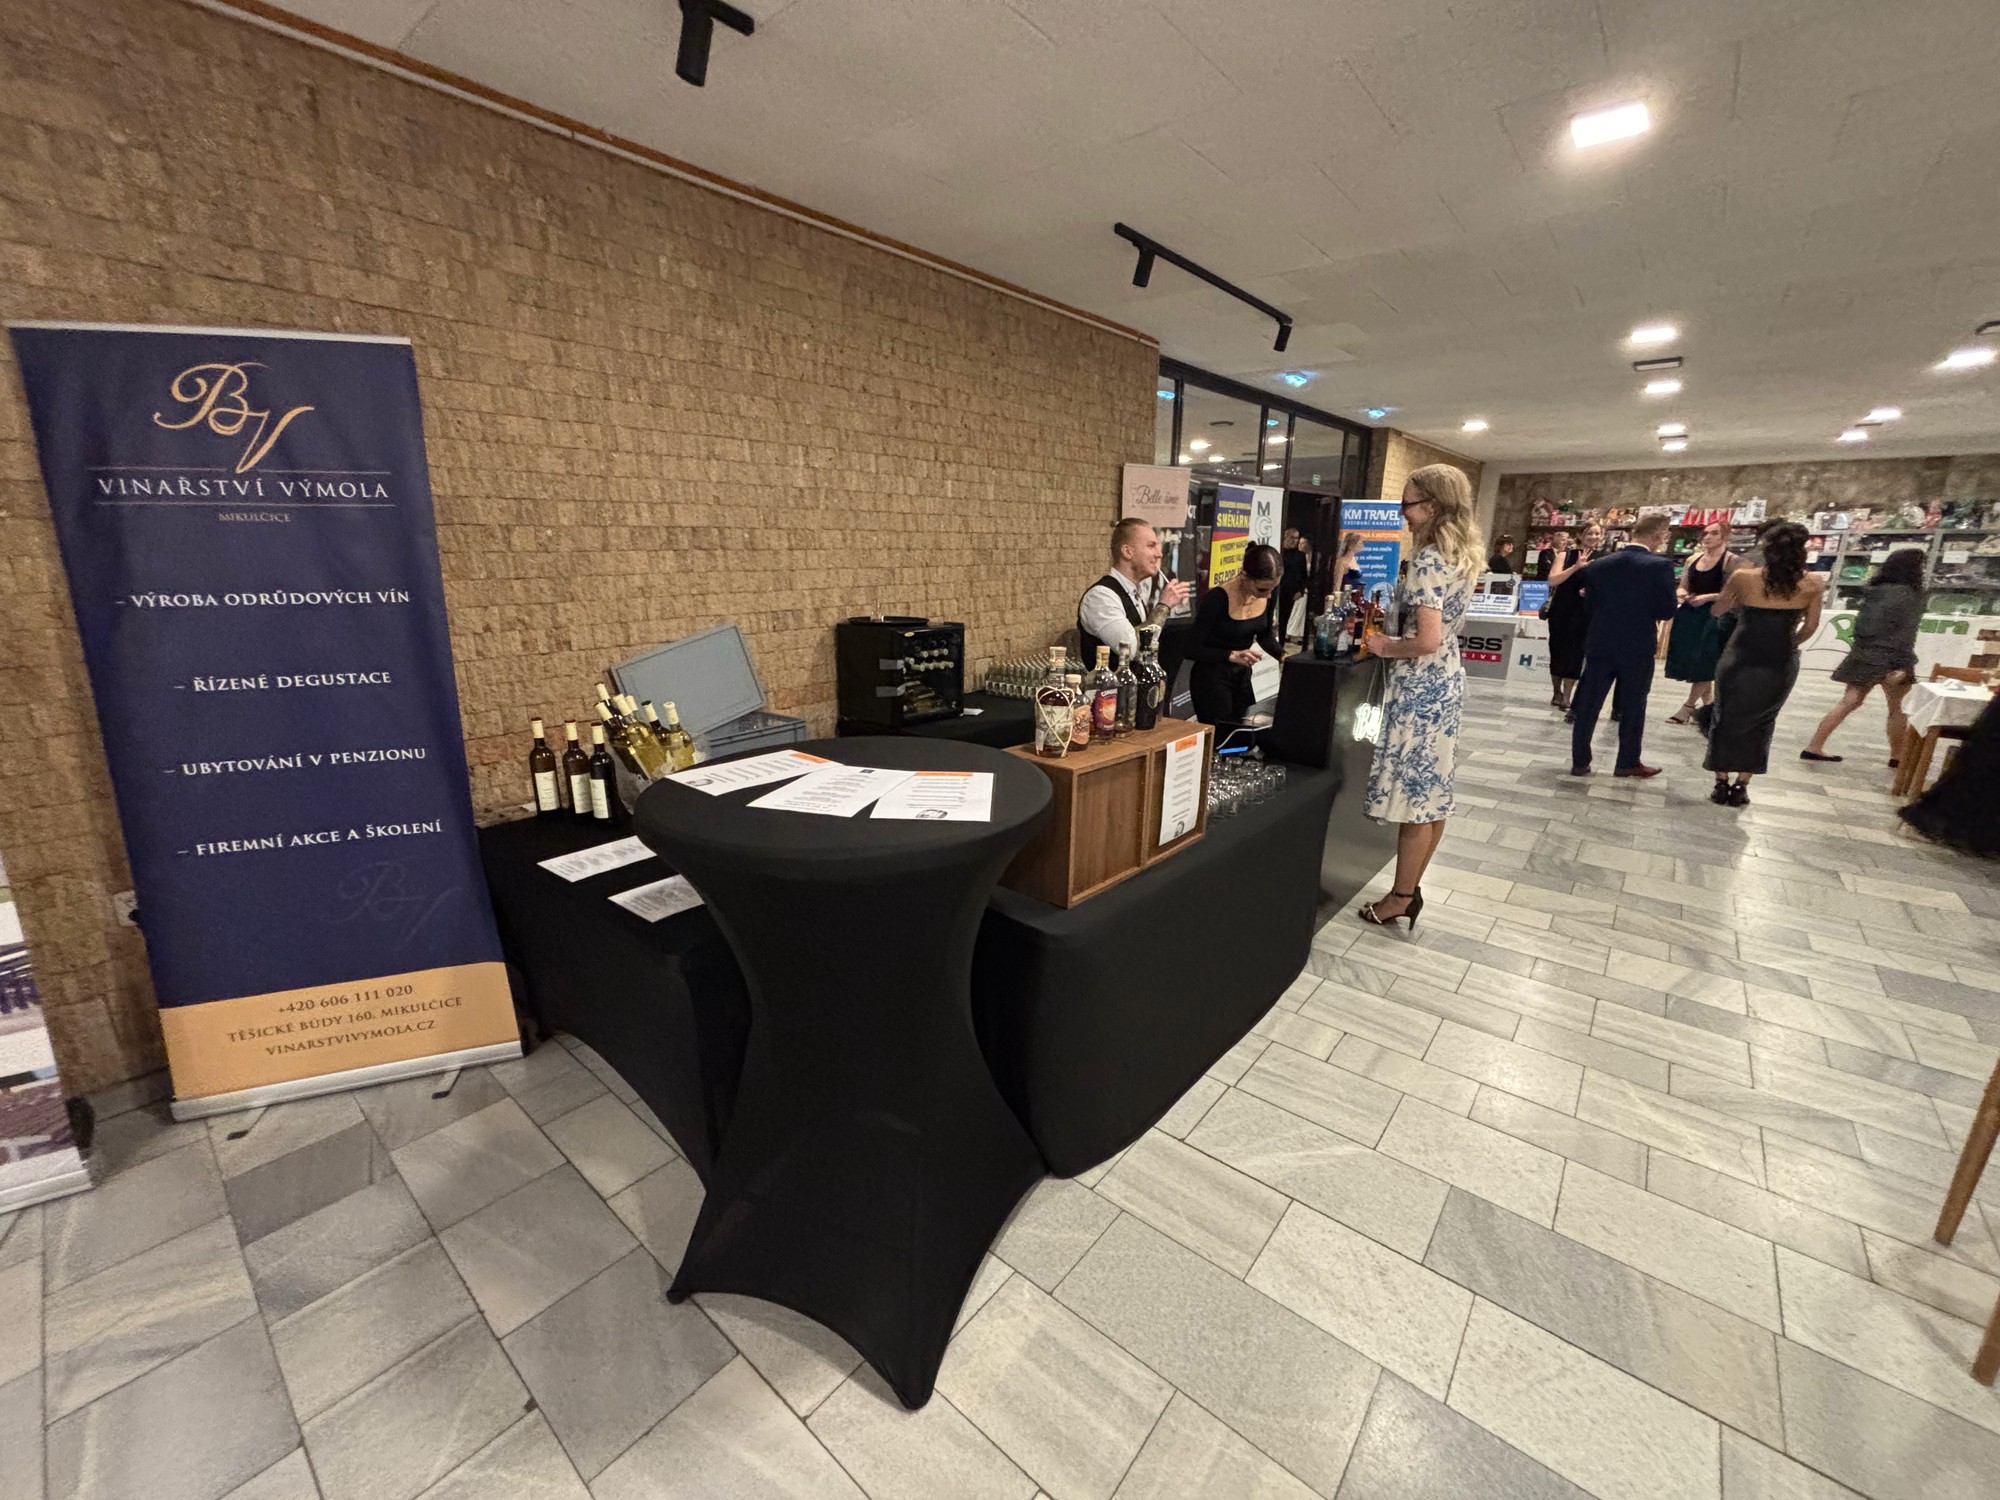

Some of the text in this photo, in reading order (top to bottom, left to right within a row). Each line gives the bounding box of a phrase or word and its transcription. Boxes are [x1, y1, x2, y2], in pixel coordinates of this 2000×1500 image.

[98, 477, 389, 499] VINAŘSTVÍ VÝMOLA
[219, 511, 292, 522] MIKULČICE
[1216, 509, 1250, 528] SMĚNÁRN
[1344, 509, 1400, 521] KM TRAVEL
[130, 588, 410, 608] VÝROBA ODRŮDOVÝCH VÍN
[193, 672, 392, 692] ŘÍZENÉ DEGUSTACE
[182, 748, 427, 776] UBYTOVÁNÍ V PENZIONU
[196, 819, 442, 856] FIREMNÍ AKCE A ŠKOLENÍ
[278, 984, 413, 1014] +420 606 111 020
[381, 996, 463, 1018] MIKULČICE
[265, 1019, 436, 1056] VINARSTVIVYMOLA.CZ
